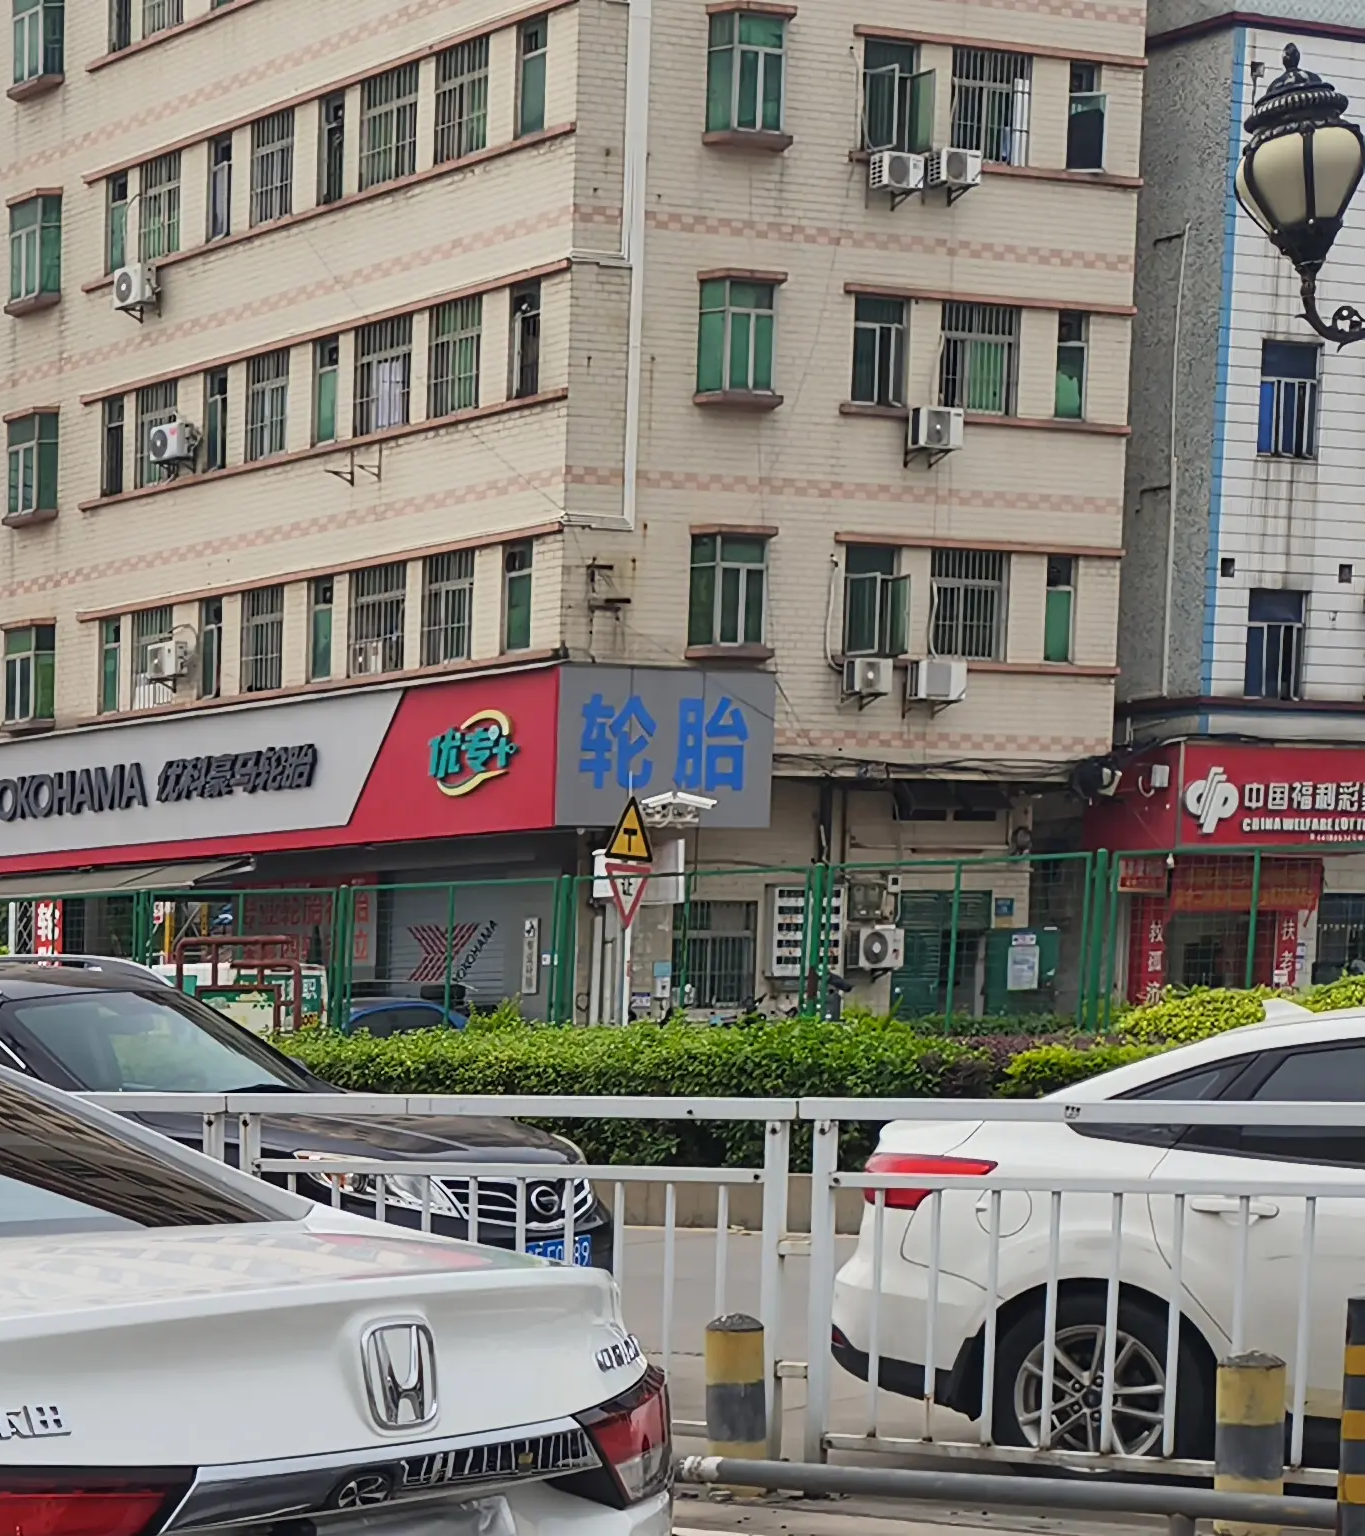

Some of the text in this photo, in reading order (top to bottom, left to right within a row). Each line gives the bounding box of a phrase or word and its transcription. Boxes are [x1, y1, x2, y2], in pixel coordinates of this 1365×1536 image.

[578, 693, 749, 792] 轮胎
[156, 743, 317, 804] 优科豪马轮胎
[1244, 781, 1365, 812] 中国福利彩
[1242, 817, 1281, 831] CHINA
